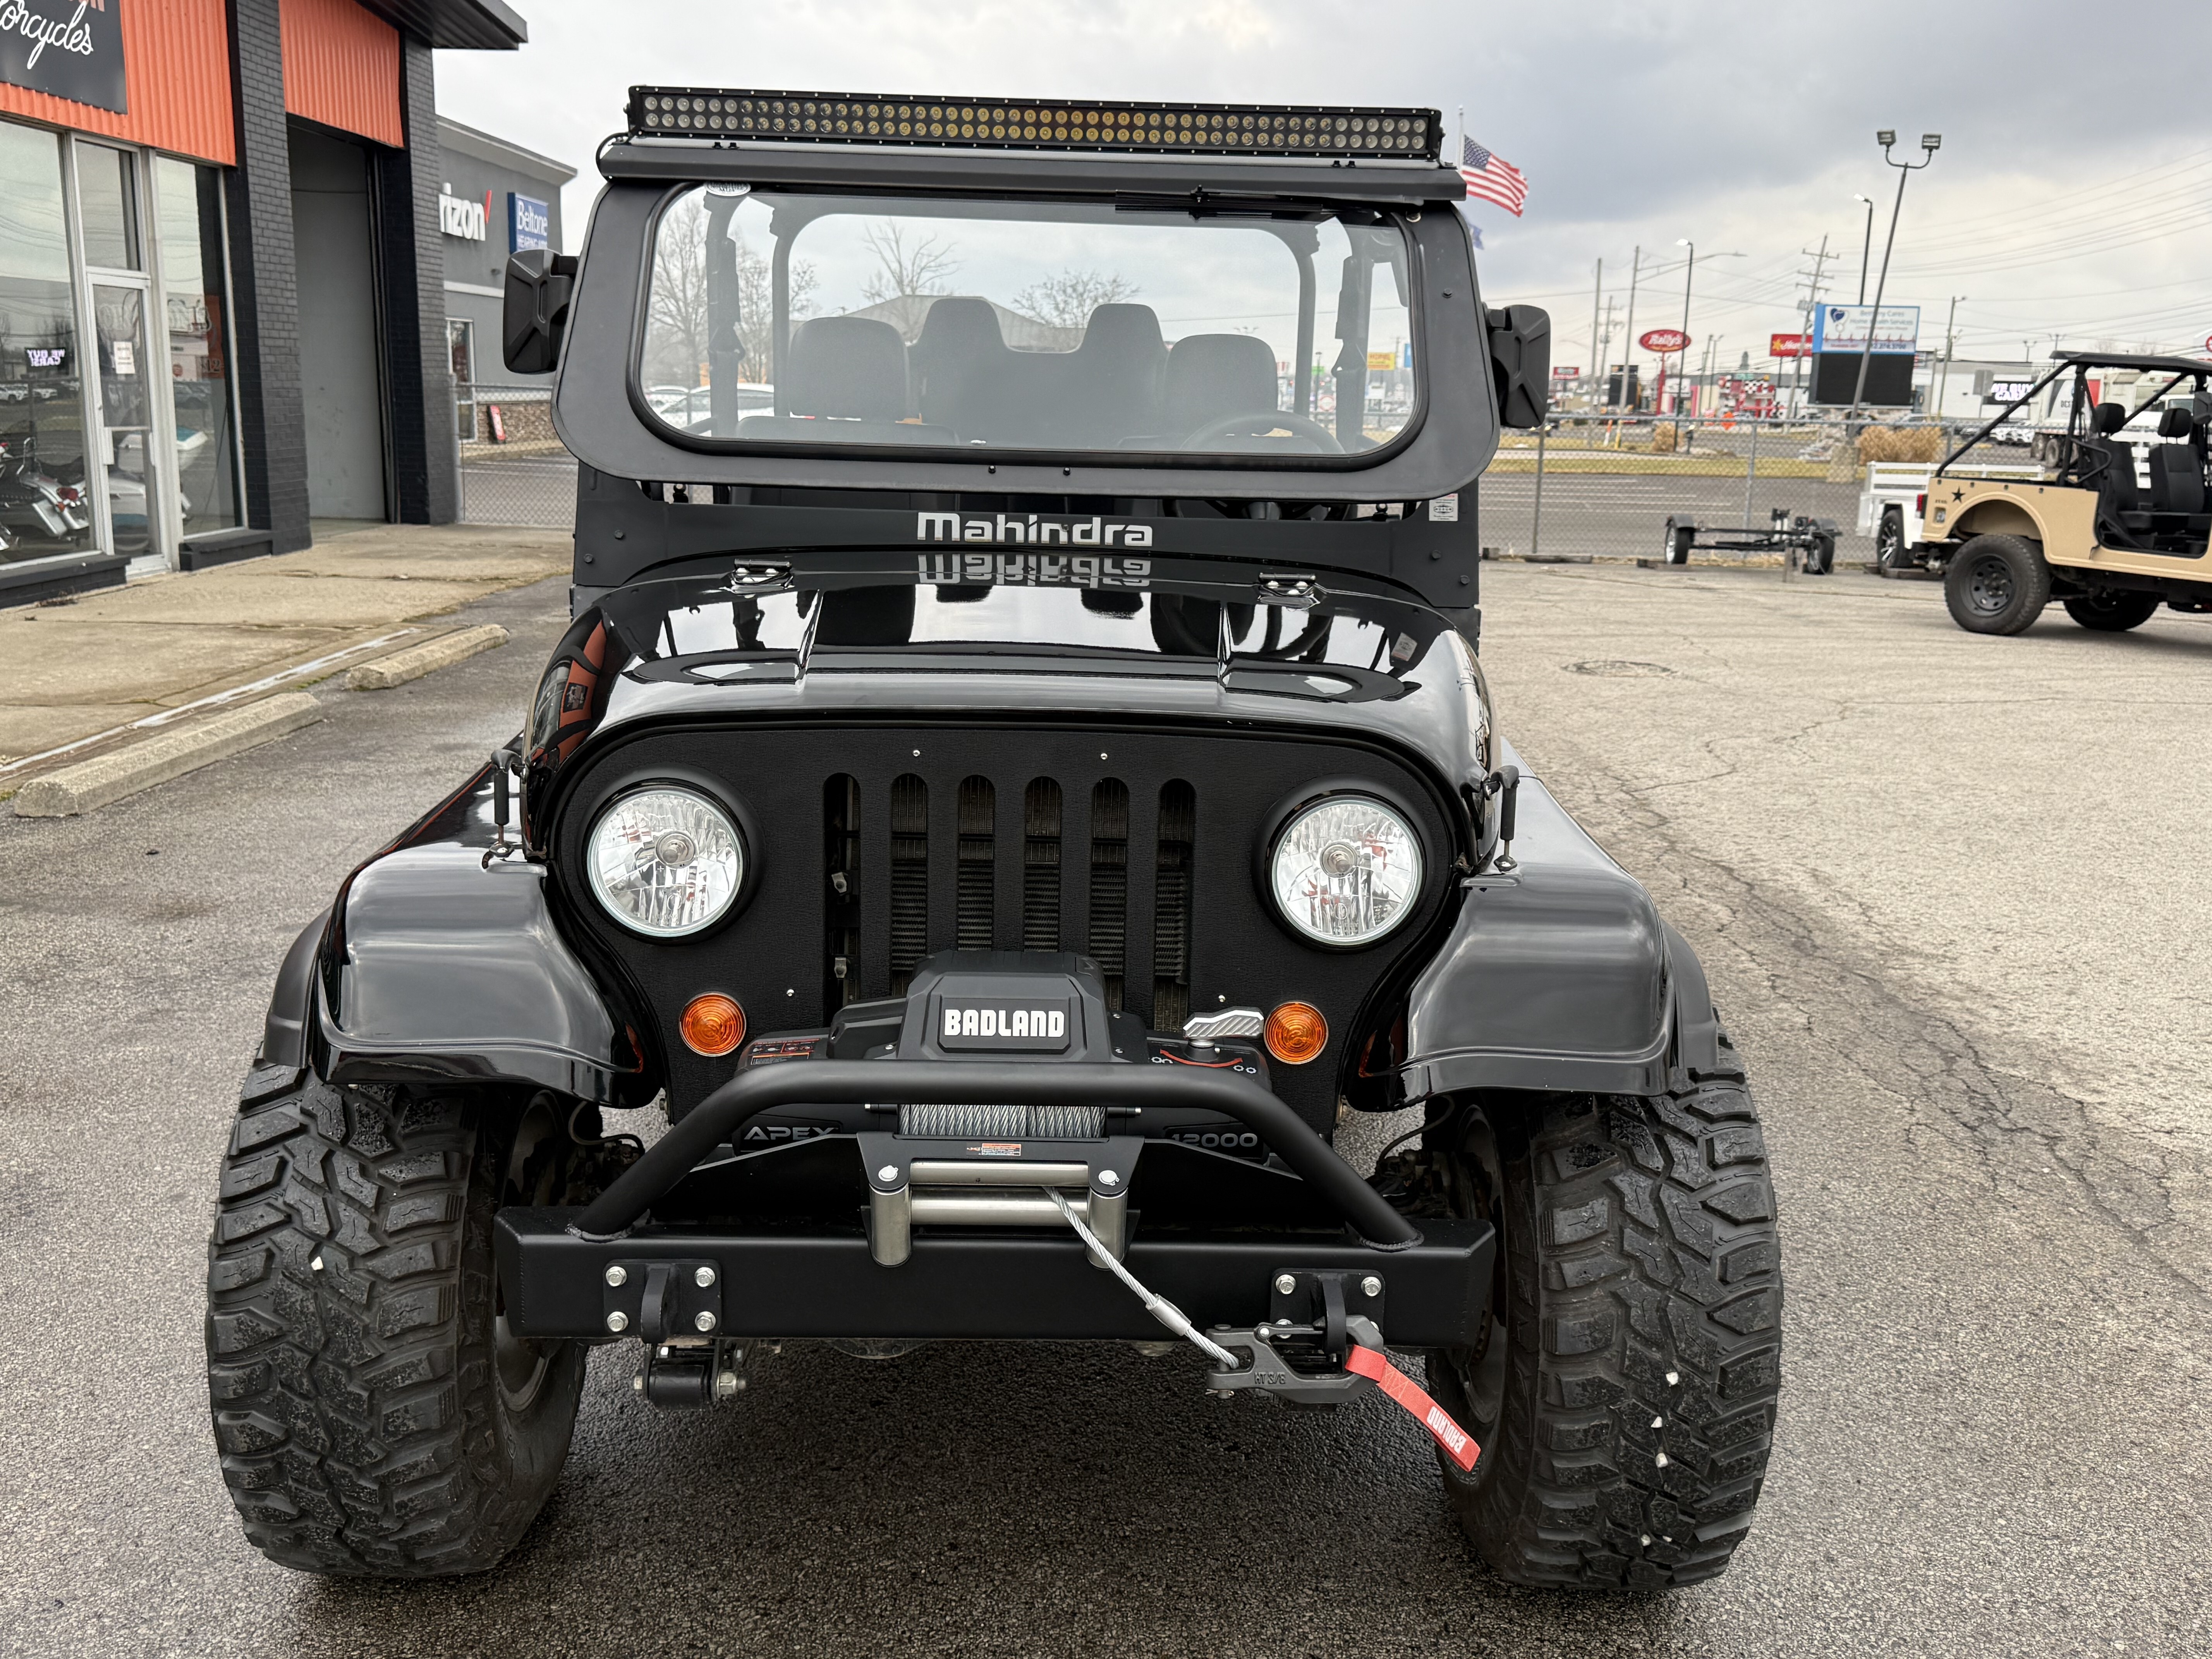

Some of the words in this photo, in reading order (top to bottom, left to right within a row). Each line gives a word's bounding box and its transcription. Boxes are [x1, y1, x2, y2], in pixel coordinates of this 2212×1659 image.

[517, 200, 548, 236] Beltone
[917, 512, 1153, 547] Mahindra
[944, 1009, 1065, 1037] BADLAND
[744, 1126, 836, 1141] APEX
[1171, 1133, 1258, 1147] 12000
[1426, 1406, 1467, 1454] BADLAND
